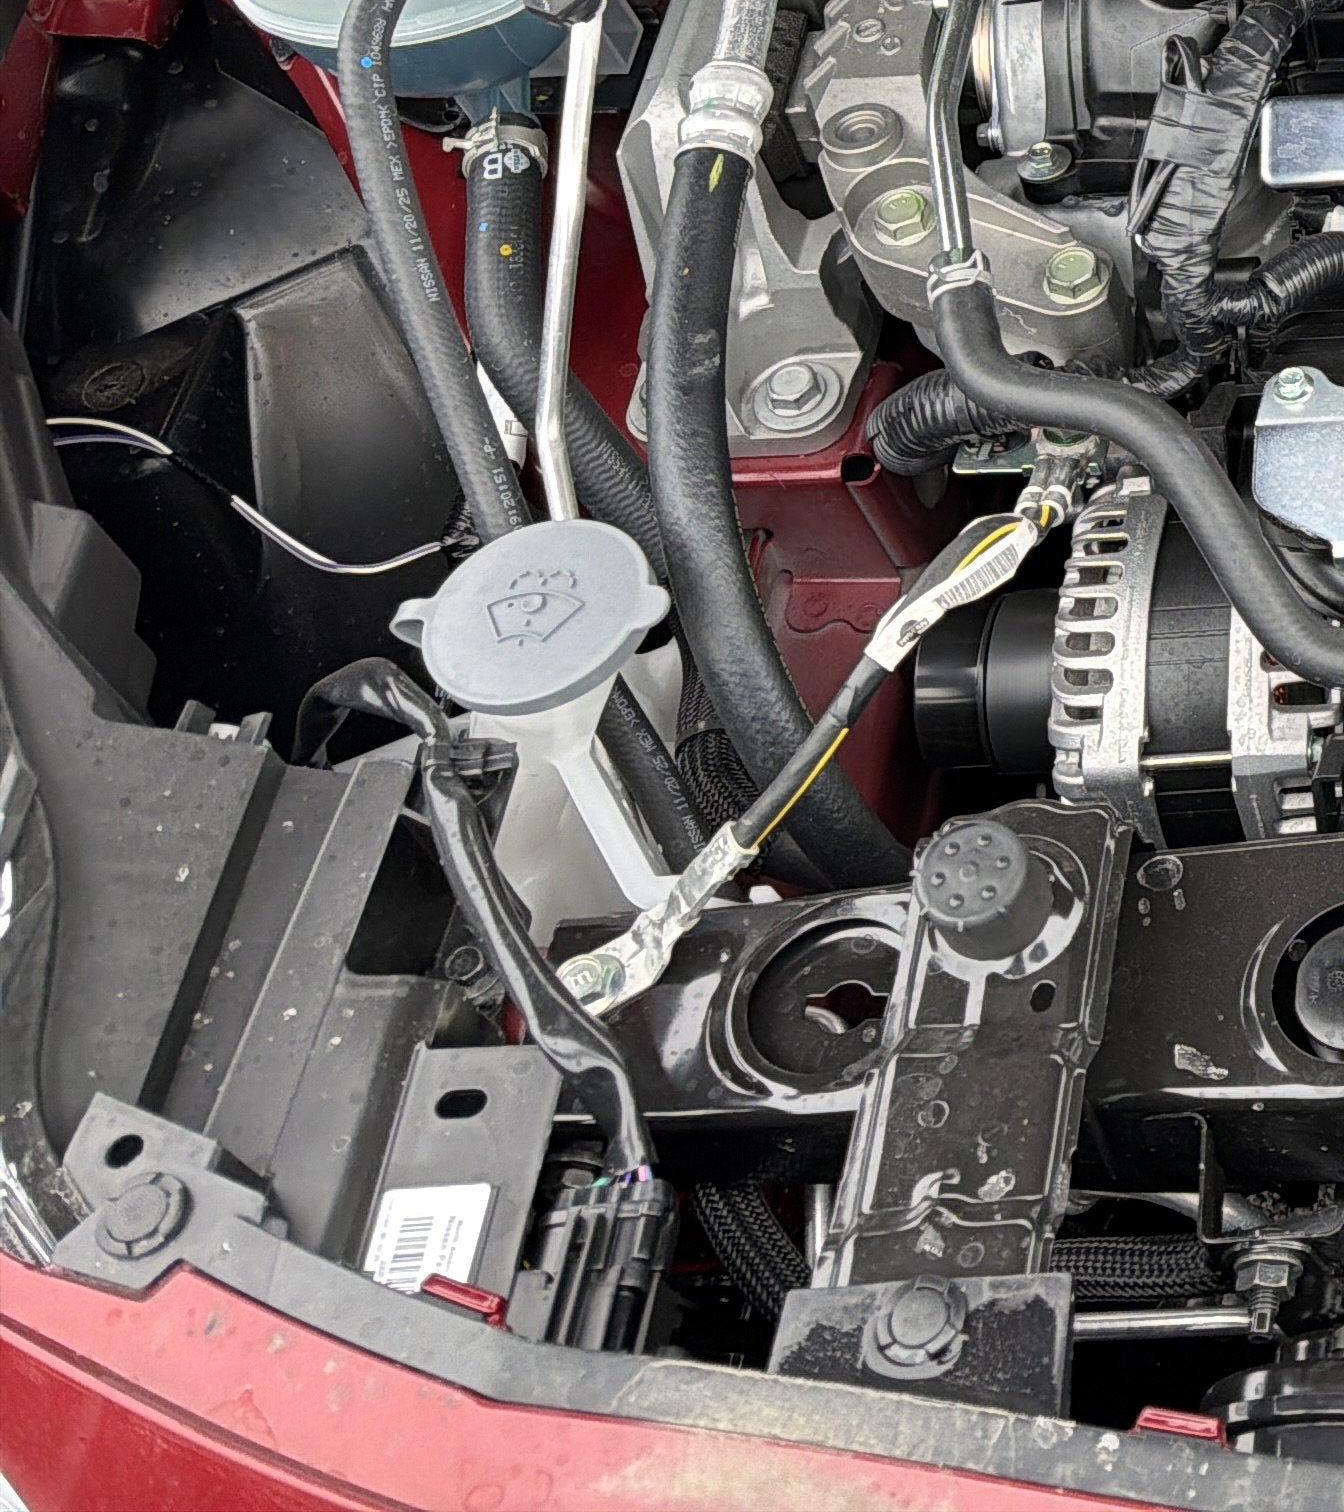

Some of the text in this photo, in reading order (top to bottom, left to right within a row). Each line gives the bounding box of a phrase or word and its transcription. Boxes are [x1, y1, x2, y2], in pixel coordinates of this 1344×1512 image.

[389, 155, 405, 181] MEX
[483, 153, 503, 180] B
[394, 187, 425, 251] 11/20/25
[415, 258, 441, 303] NISSAN
[636, 728, 658, 753] MEX
[652, 755, 689, 811] 11/20/25
